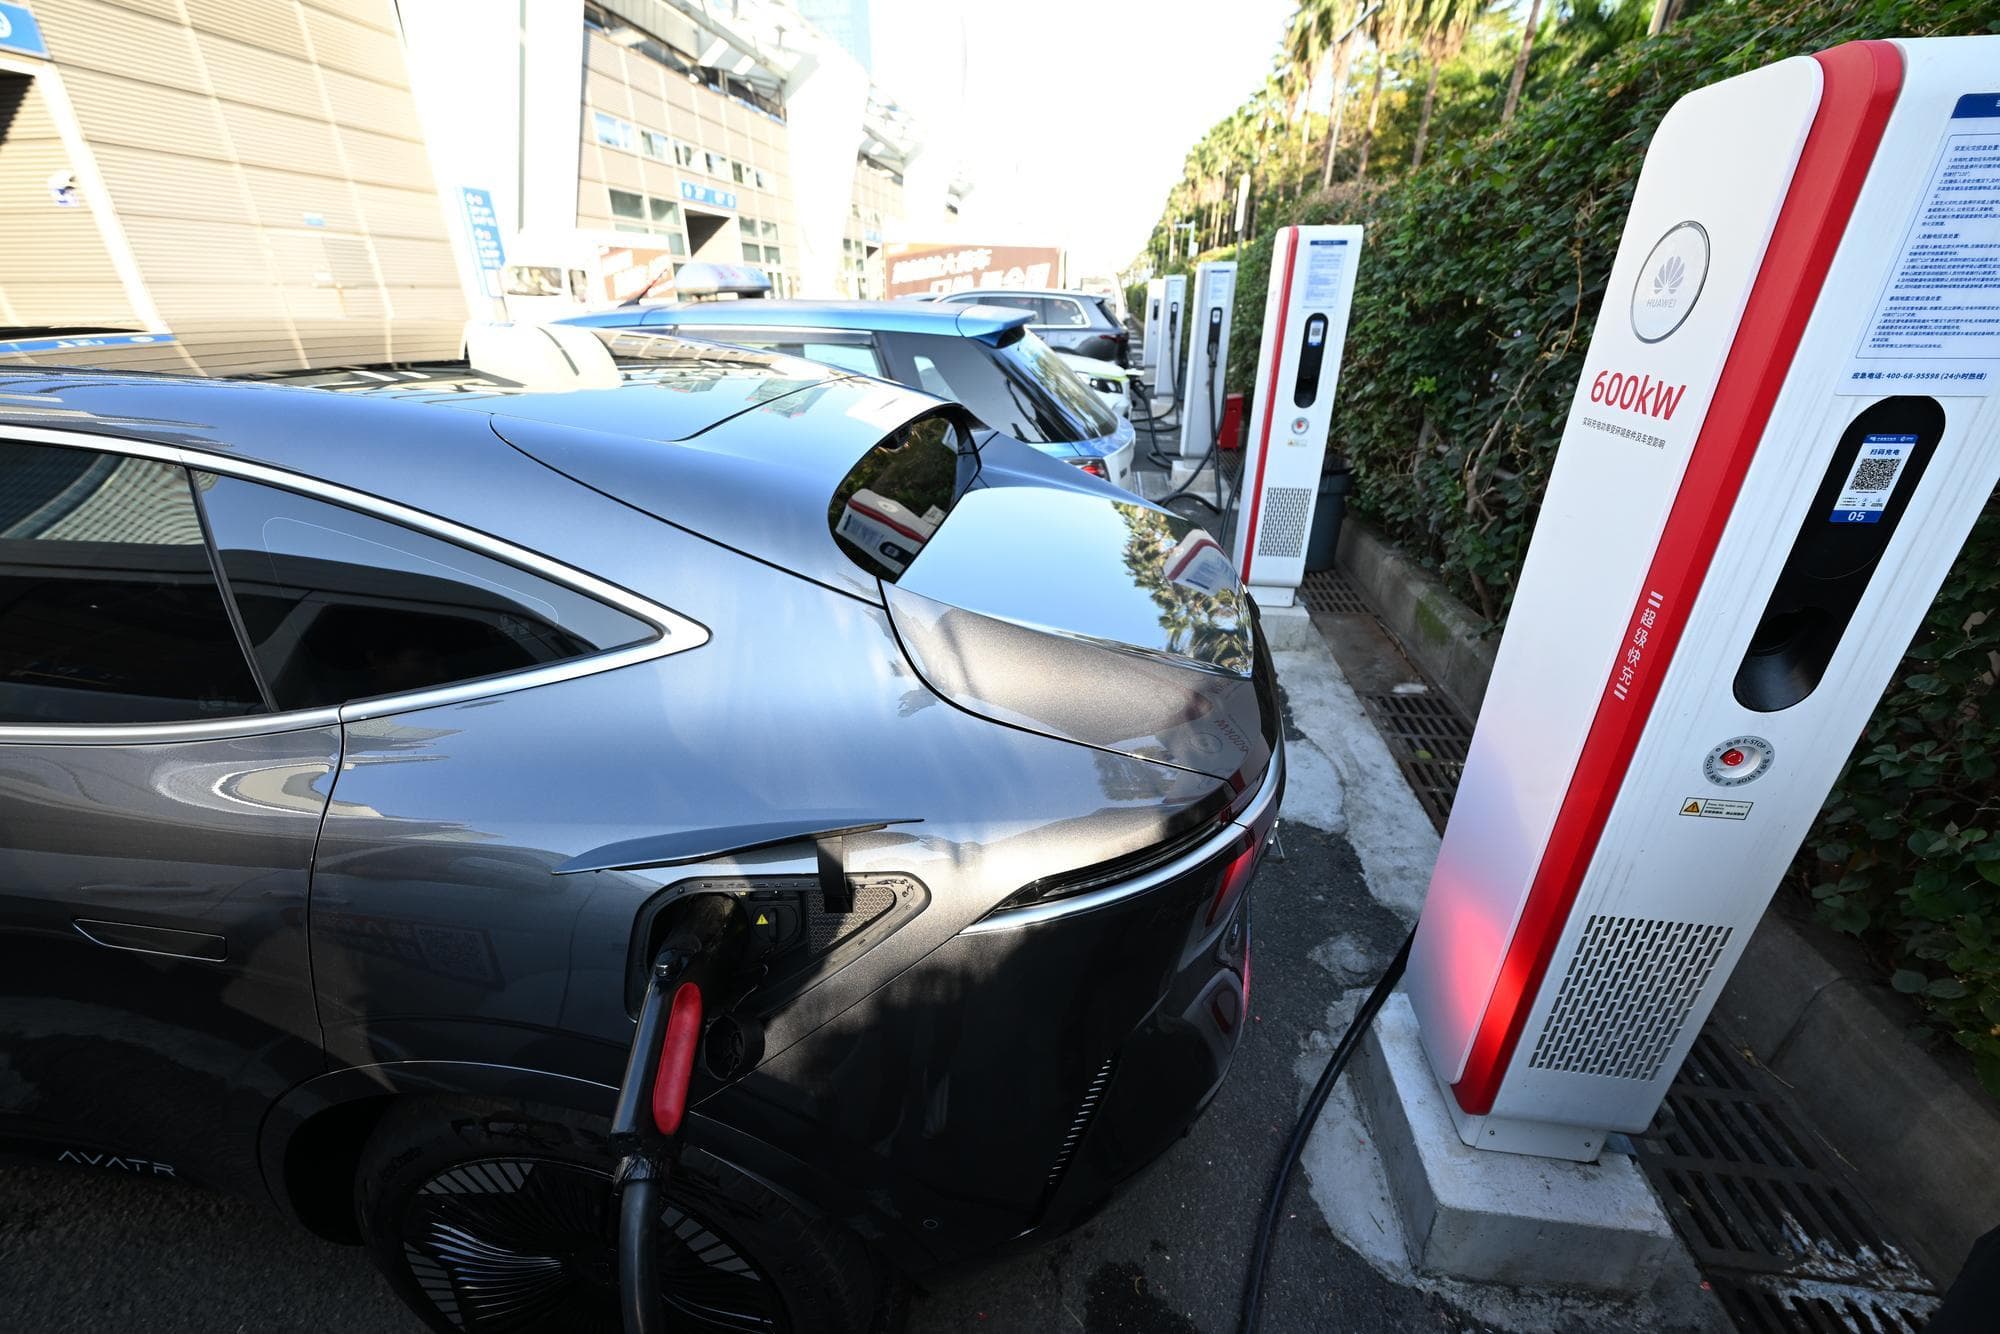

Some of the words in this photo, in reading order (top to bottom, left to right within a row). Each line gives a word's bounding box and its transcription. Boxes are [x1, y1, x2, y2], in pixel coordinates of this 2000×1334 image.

[1646, 297, 1677, 309] HUAWEI
[1590, 370, 1687, 421] 600kW
[1847, 511, 1866, 521] 05
[1619, 607, 1656, 686] 超级快充
[1743, 738, 1767, 749] E-STOP
[58, 1150, 176, 1177] AVATR
